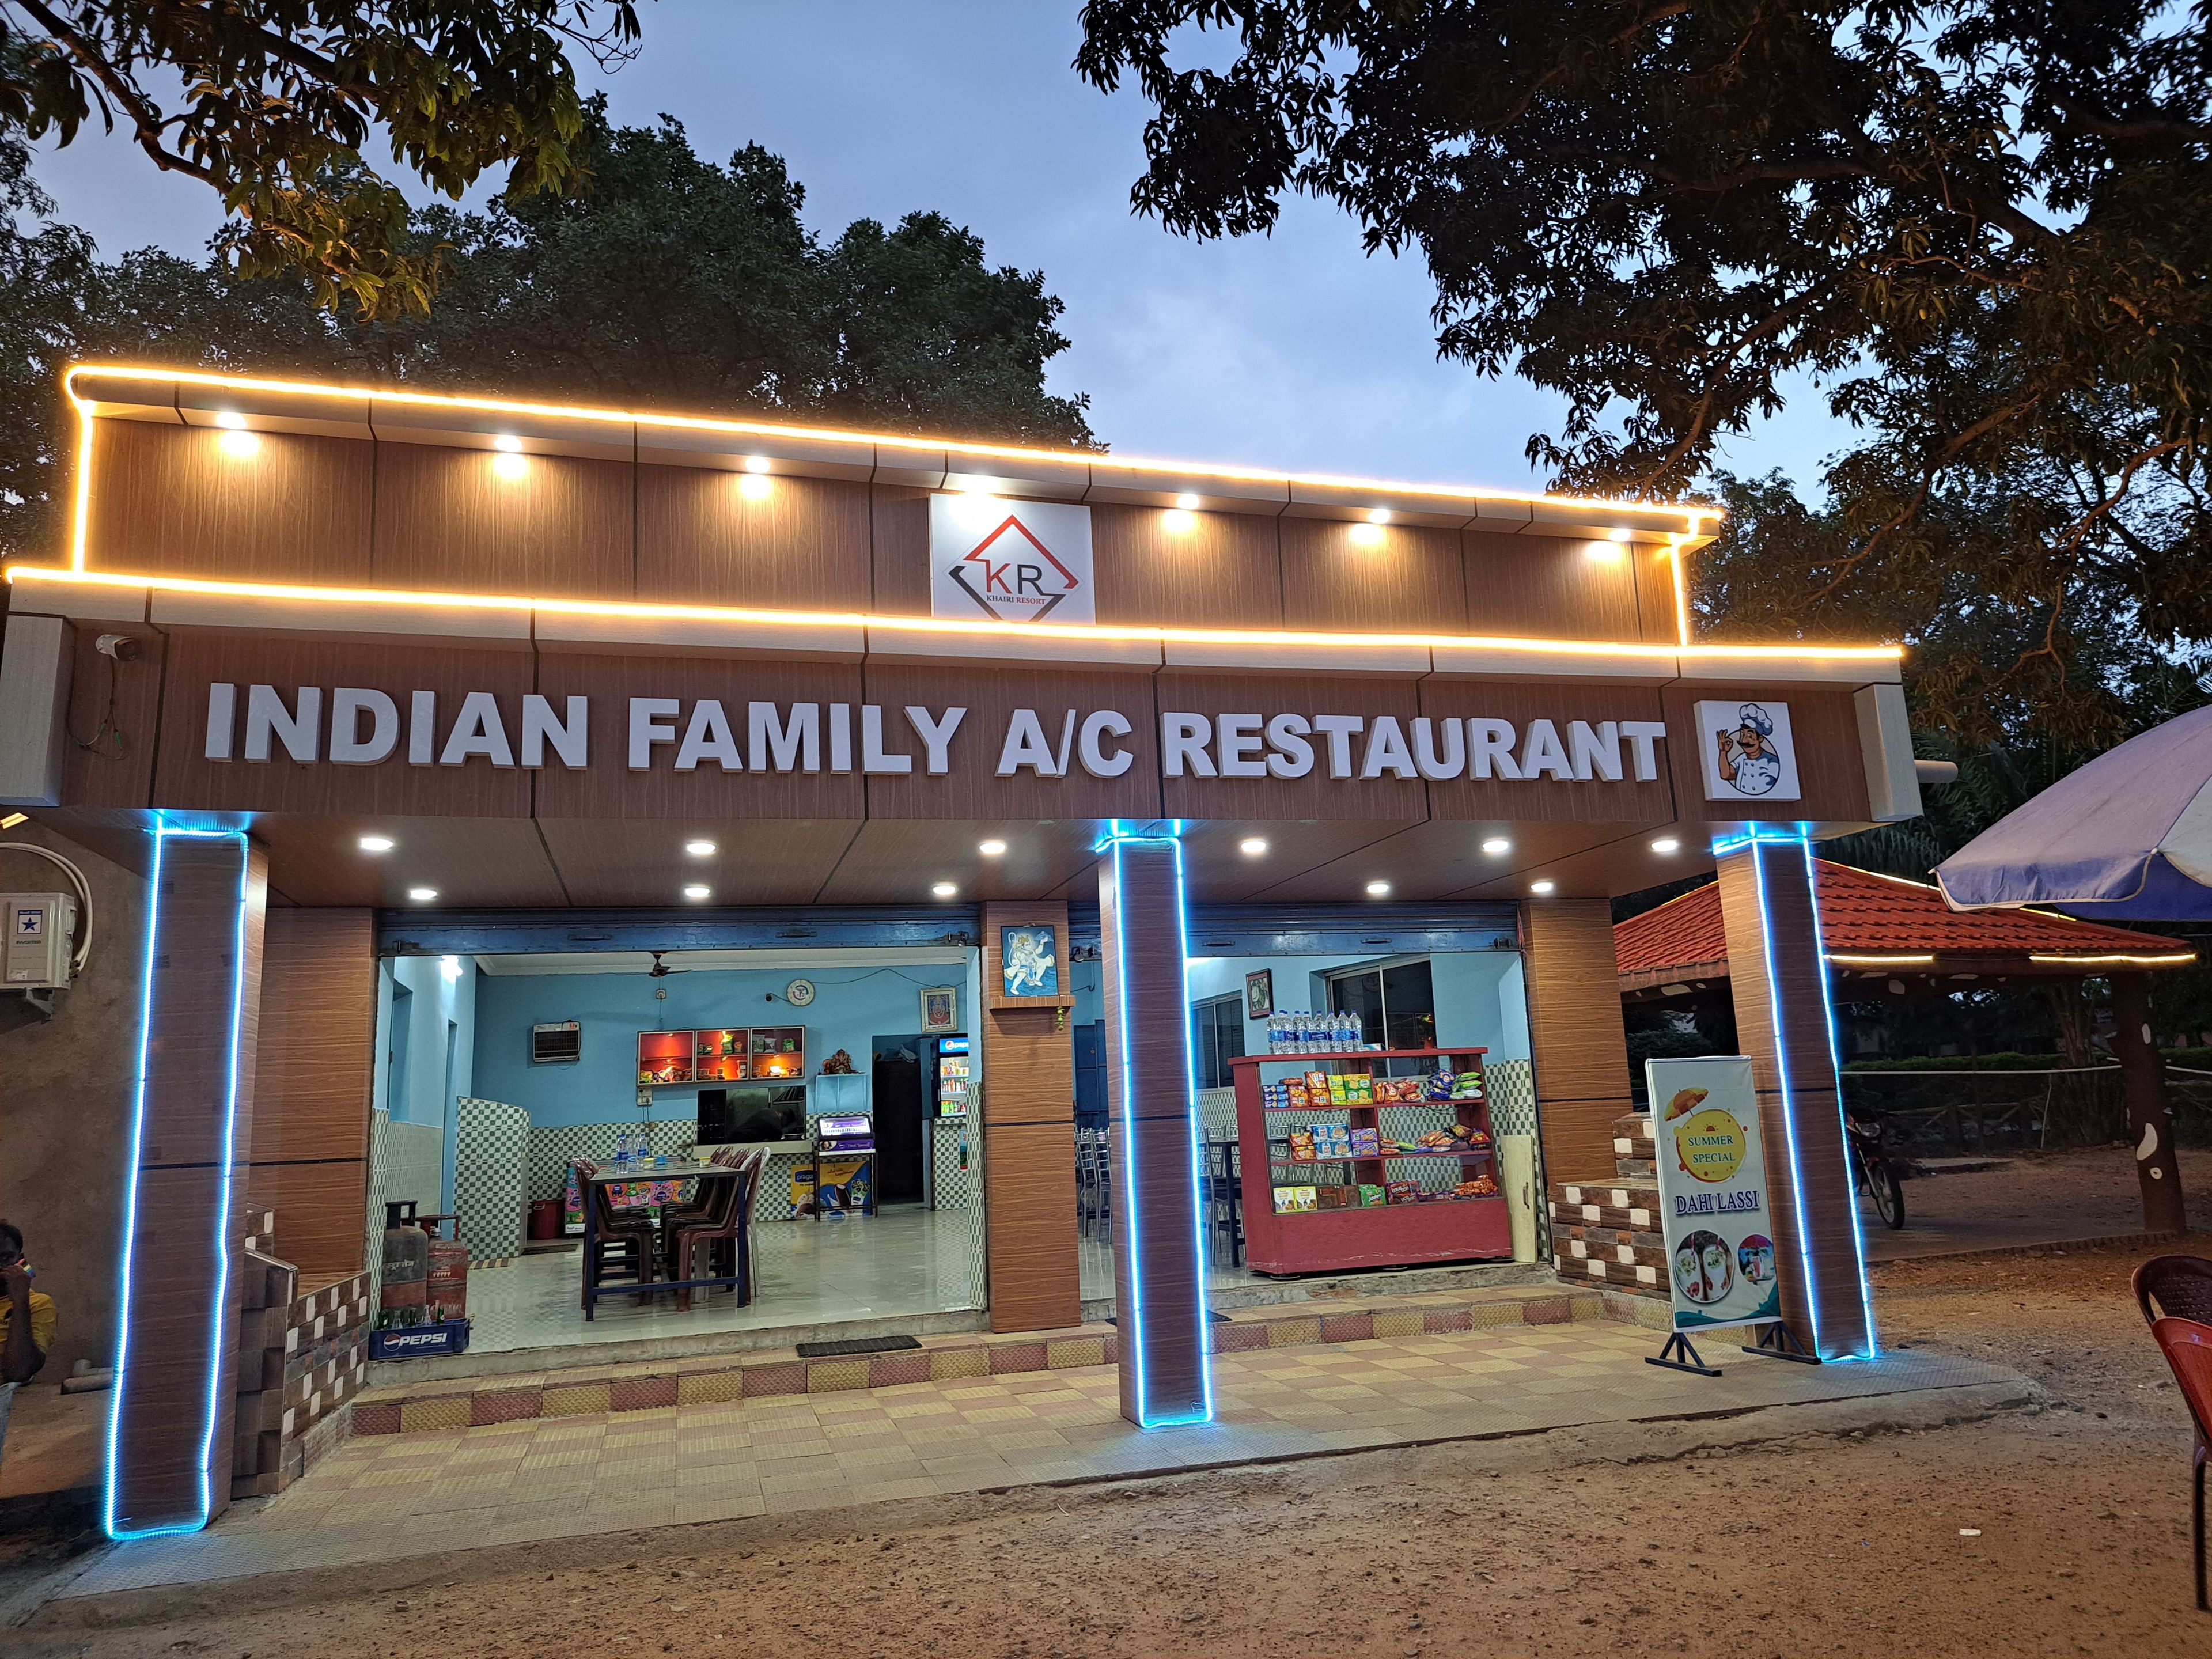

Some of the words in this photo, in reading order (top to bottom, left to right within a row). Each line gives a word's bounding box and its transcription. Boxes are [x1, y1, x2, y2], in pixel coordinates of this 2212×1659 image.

[986, 560, 1044, 594] KR
[986, 594, 1014, 603] KHAIRI
[204, 682, 588, 770] INDIAN
[628, 698, 968, 776] FAMILY
[994, 708, 1134, 779] A/C
[1159, 711, 1666, 783] RESTAURANT
[1688, 1134, 1733, 1147] SUMMER
[1692, 1152, 1736, 1164] SPECIAL
[1675, 1194, 1714, 1213] DAHI
[1716, 1190, 1759, 1211] LASSI
[399, 1332, 448, 1346] PEPSI
